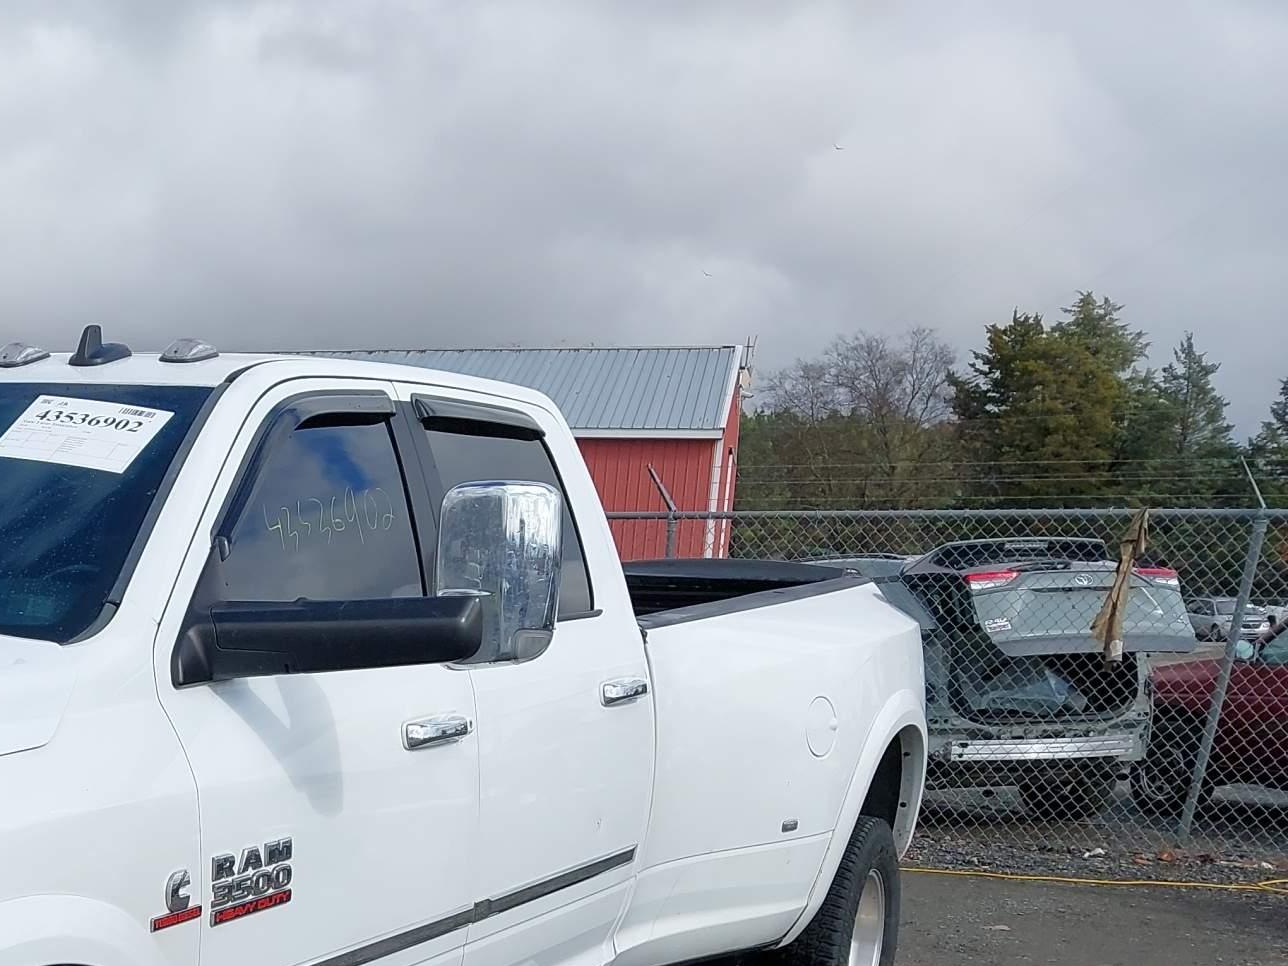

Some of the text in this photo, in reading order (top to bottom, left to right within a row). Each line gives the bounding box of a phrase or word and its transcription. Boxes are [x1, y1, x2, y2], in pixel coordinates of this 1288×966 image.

[35, 409, 144, 433] 43536902
[262, 486, 396, 553] 43536902
[211, 836, 293, 882] RAM
[211, 863, 293, 909] 3500
[215, 891, 290, 923] HEAVY DUTY
